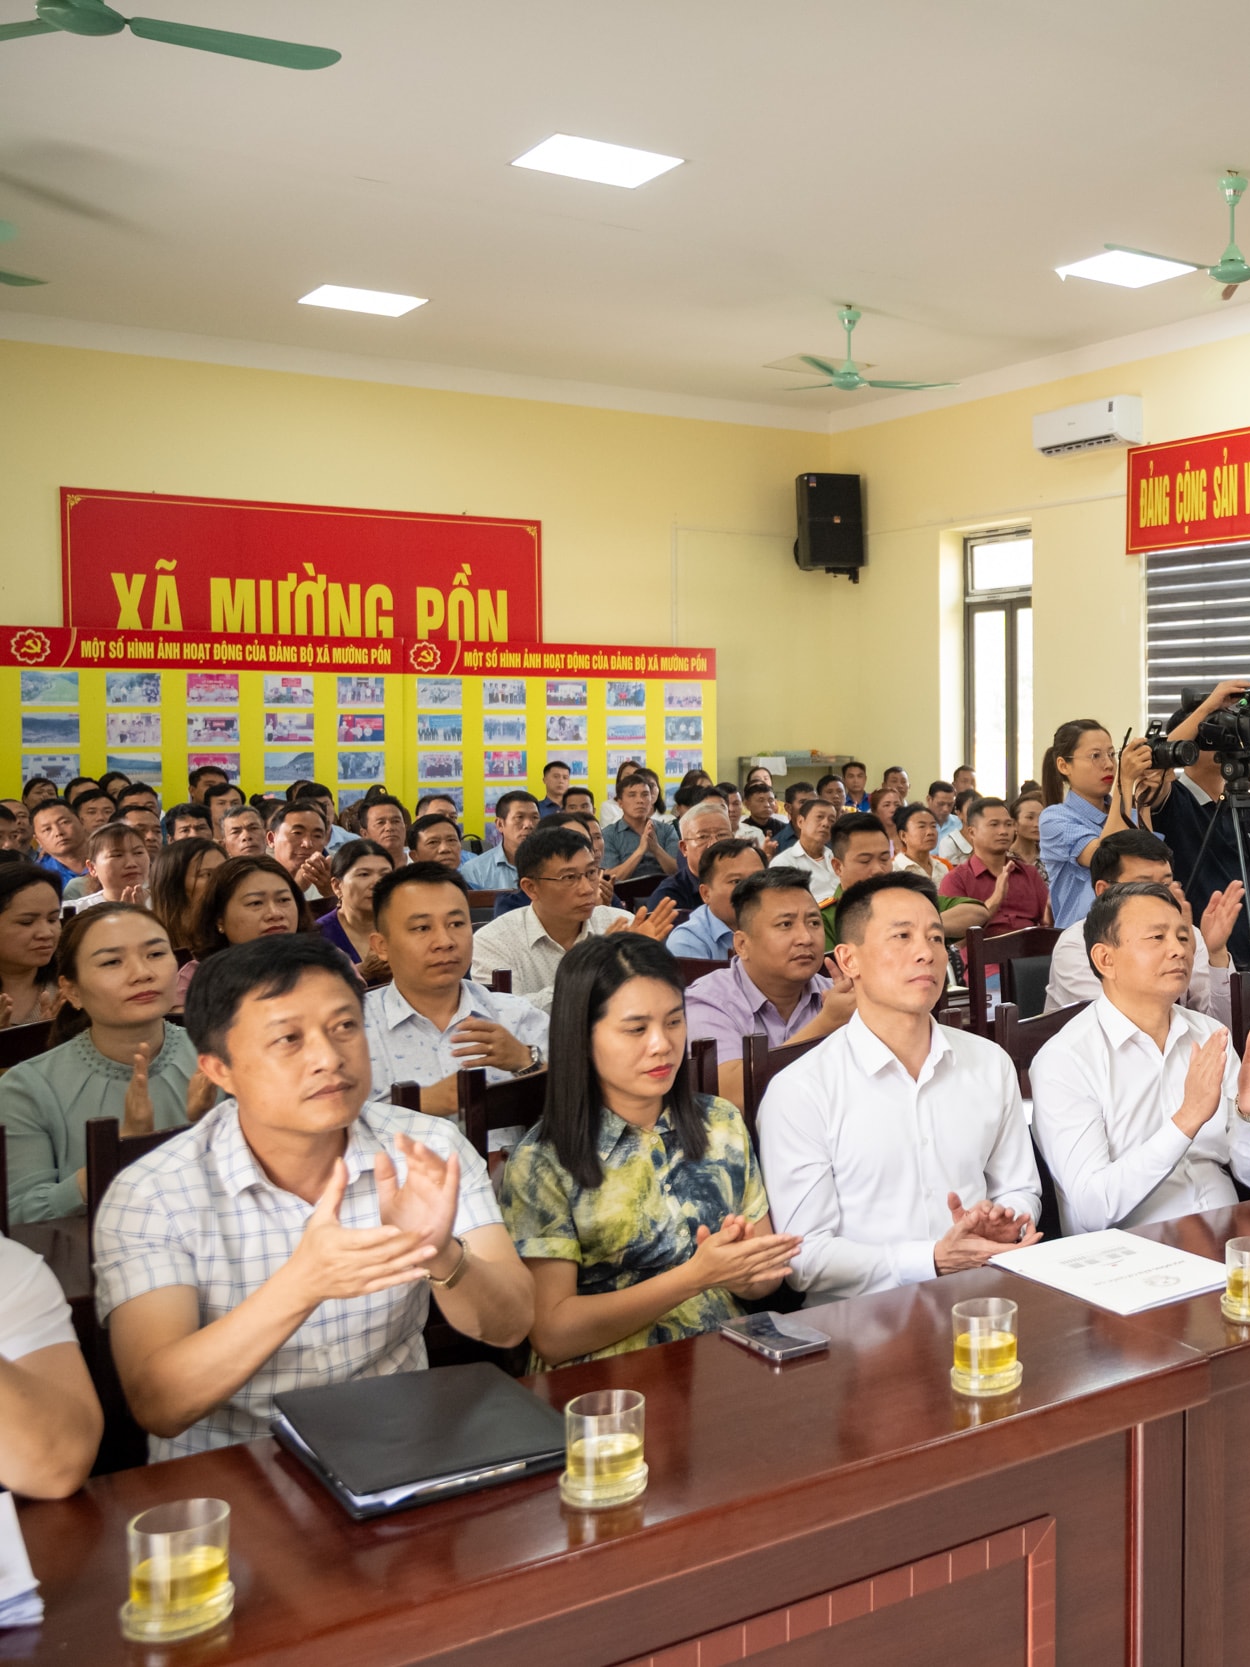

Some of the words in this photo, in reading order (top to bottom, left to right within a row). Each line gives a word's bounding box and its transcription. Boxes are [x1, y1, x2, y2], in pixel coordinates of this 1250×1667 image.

[1139, 460, 1170, 528] ĐẢNG
[1175, 460, 1207, 534] CỘNG
[1213, 447, 1238, 518] SẢN
[111, 558, 184, 630] XÃ
[210, 562, 394, 638] MƯỜNG
[416, 563, 508, 643] PỒN
[80, 637, 106, 662] MỘT
[109, 635, 125, 659] SỐ
[127, 638, 154, 659] HÌNH
[157, 636, 180, 659] ẢNH
[183, 642, 211, 663] HOẠT
[213, 640, 242, 664] ĐỘNG
[245, 639, 267, 662] CỦA
[269, 640, 297, 662] ĐẢNG
[300, 643, 314, 666] BỘ
[316, 644, 330, 663] XÃ
[333, 644, 368, 664] MƯỜNG
[464, 648, 483, 670] MỘT
[485, 647, 498, 668] SỐ
[500, 649, 521, 668] HÌNH
[523, 648, 541, 669] ẢNH
[543, 653, 565, 672] HOẠT
[567, 651, 590, 672] ĐỘNG
[592, 650, 609, 670] CỦA
[611, 651, 633, 671] ĐẢNG
[635, 653, 646, 674] BỘ
[648, 654, 659, 672] XÃ
[660, 653, 689, 672] MƯỜNG
